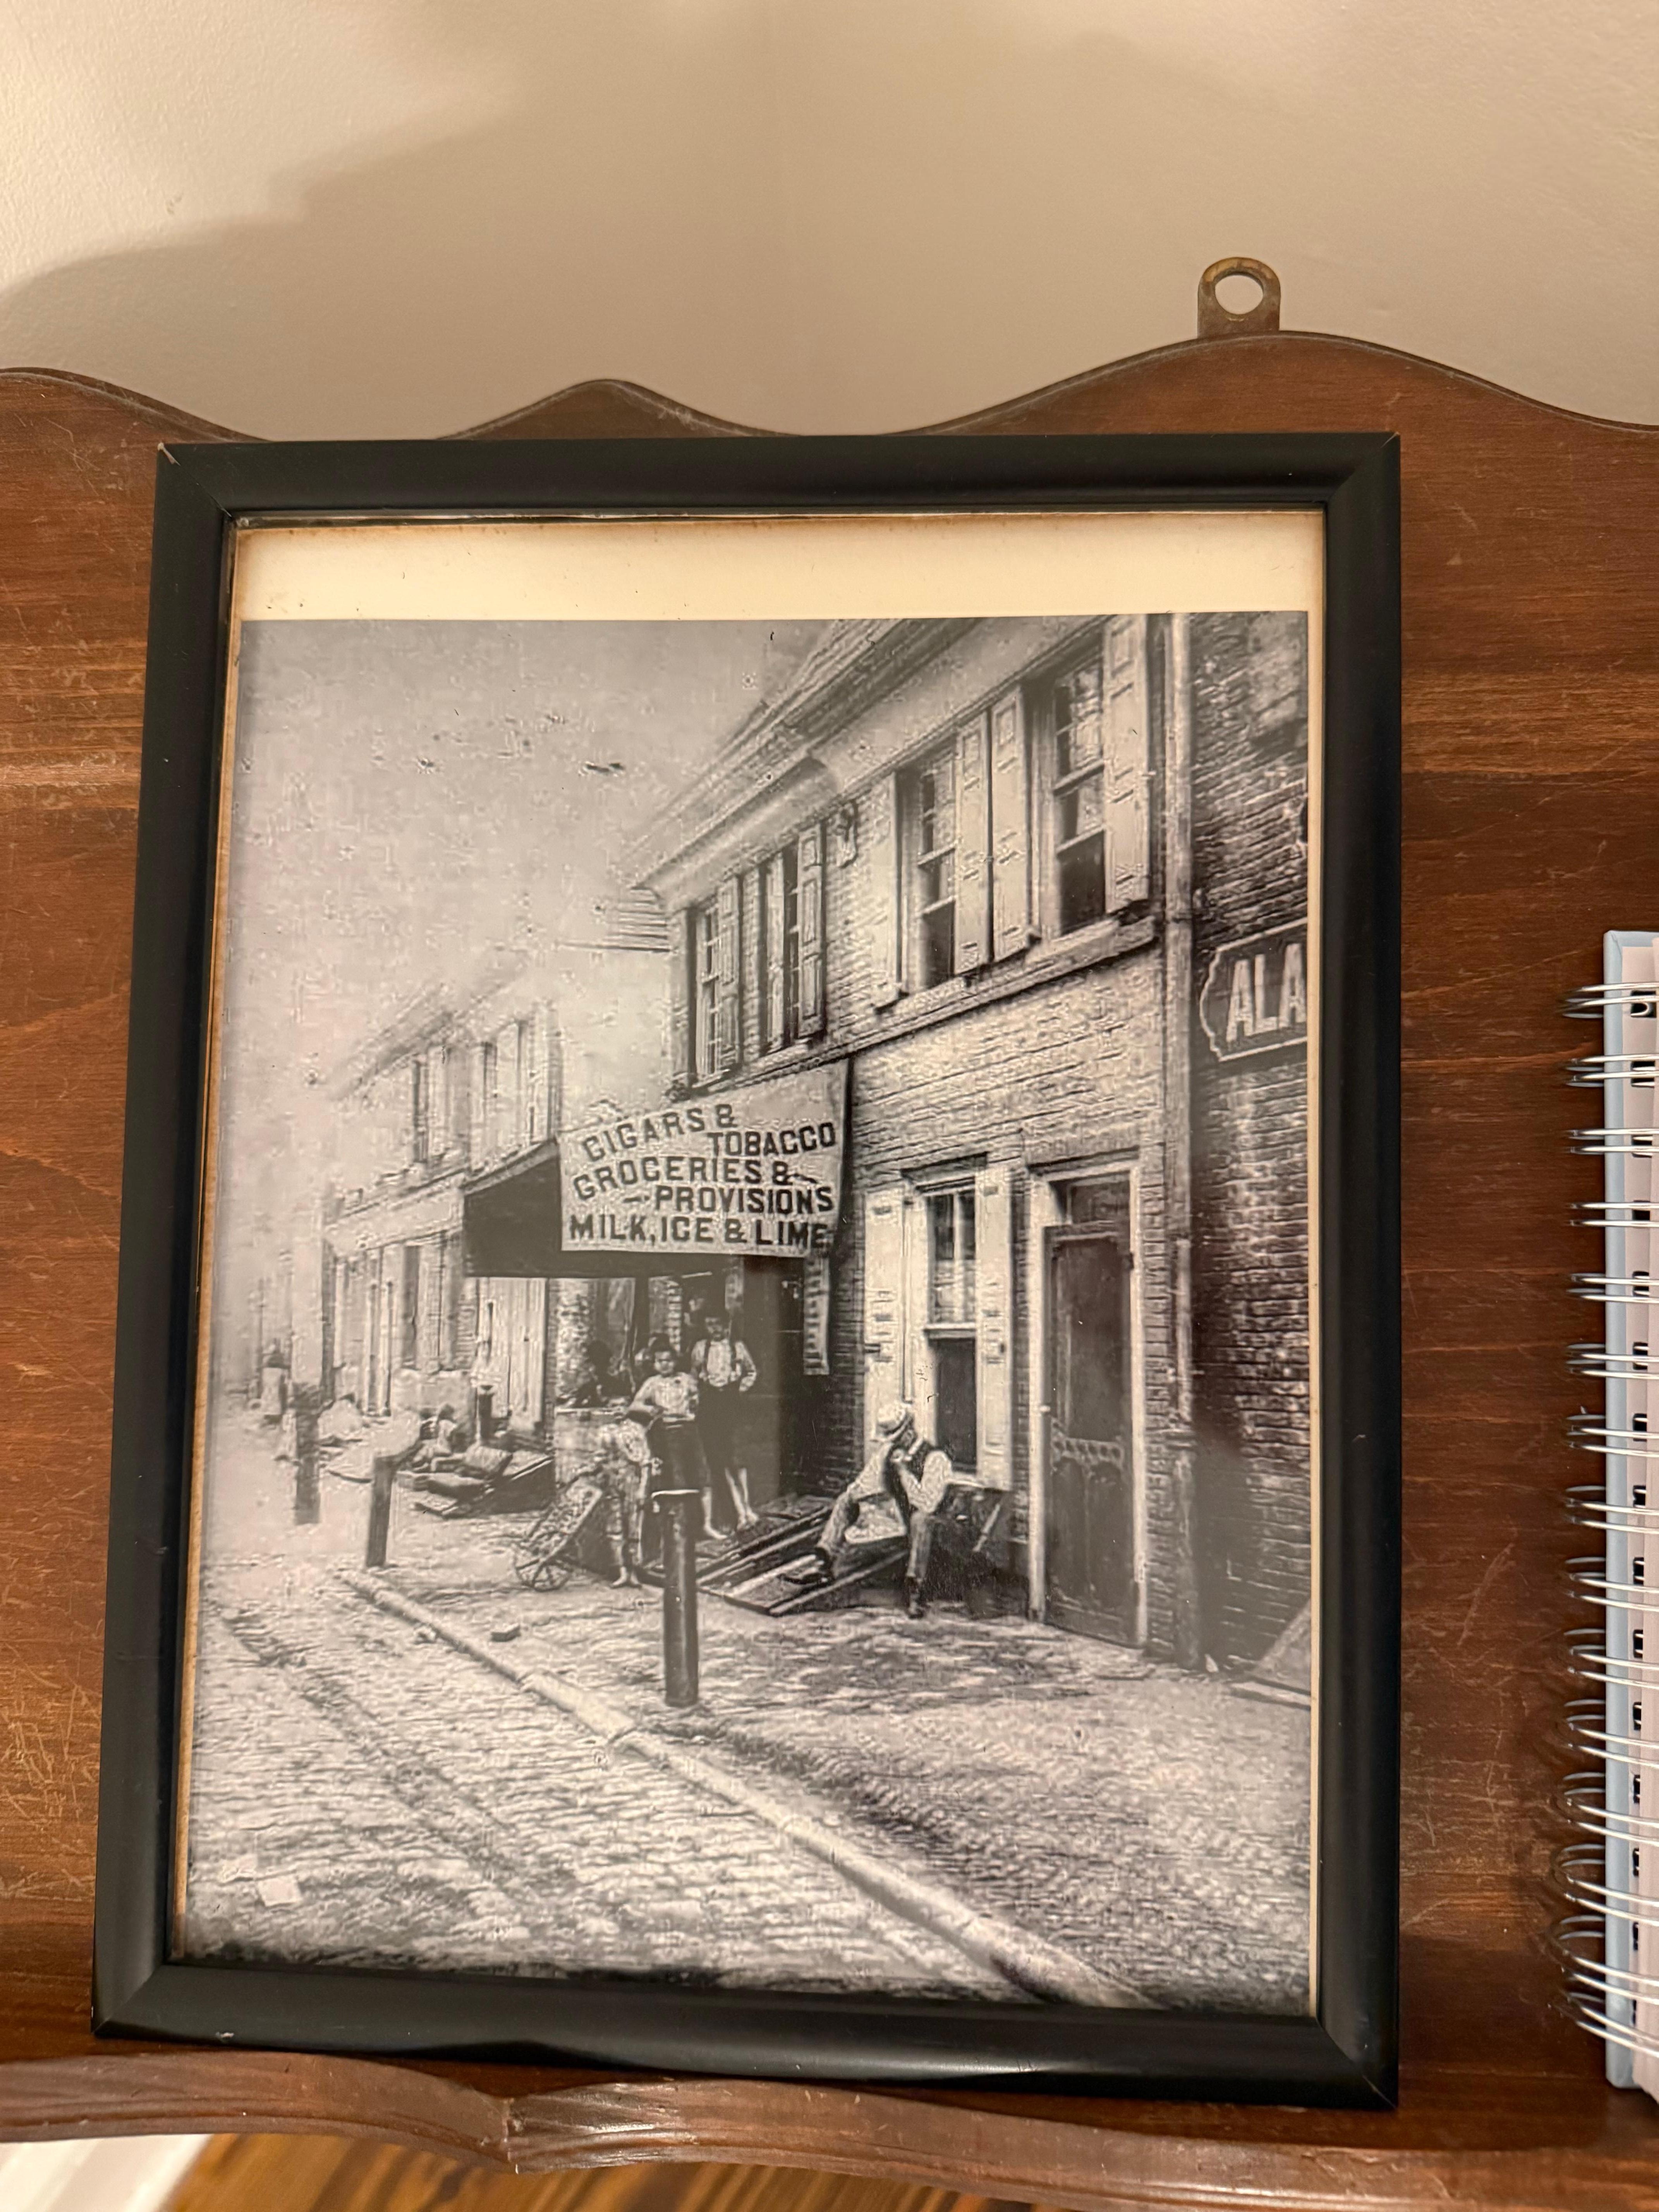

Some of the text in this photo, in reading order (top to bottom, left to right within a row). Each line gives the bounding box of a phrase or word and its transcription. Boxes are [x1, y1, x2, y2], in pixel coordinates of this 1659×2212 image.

[582, 1104, 738, 1161] CIGARS &
[707, 1122, 836, 1157] TOBACCO
[573, 1156, 763, 1200] GROCERIES
[655, 1185, 833, 1215] PROVISIONS
[724, 1218, 747, 1243] &
[756, 1219, 829, 1248] LIME
